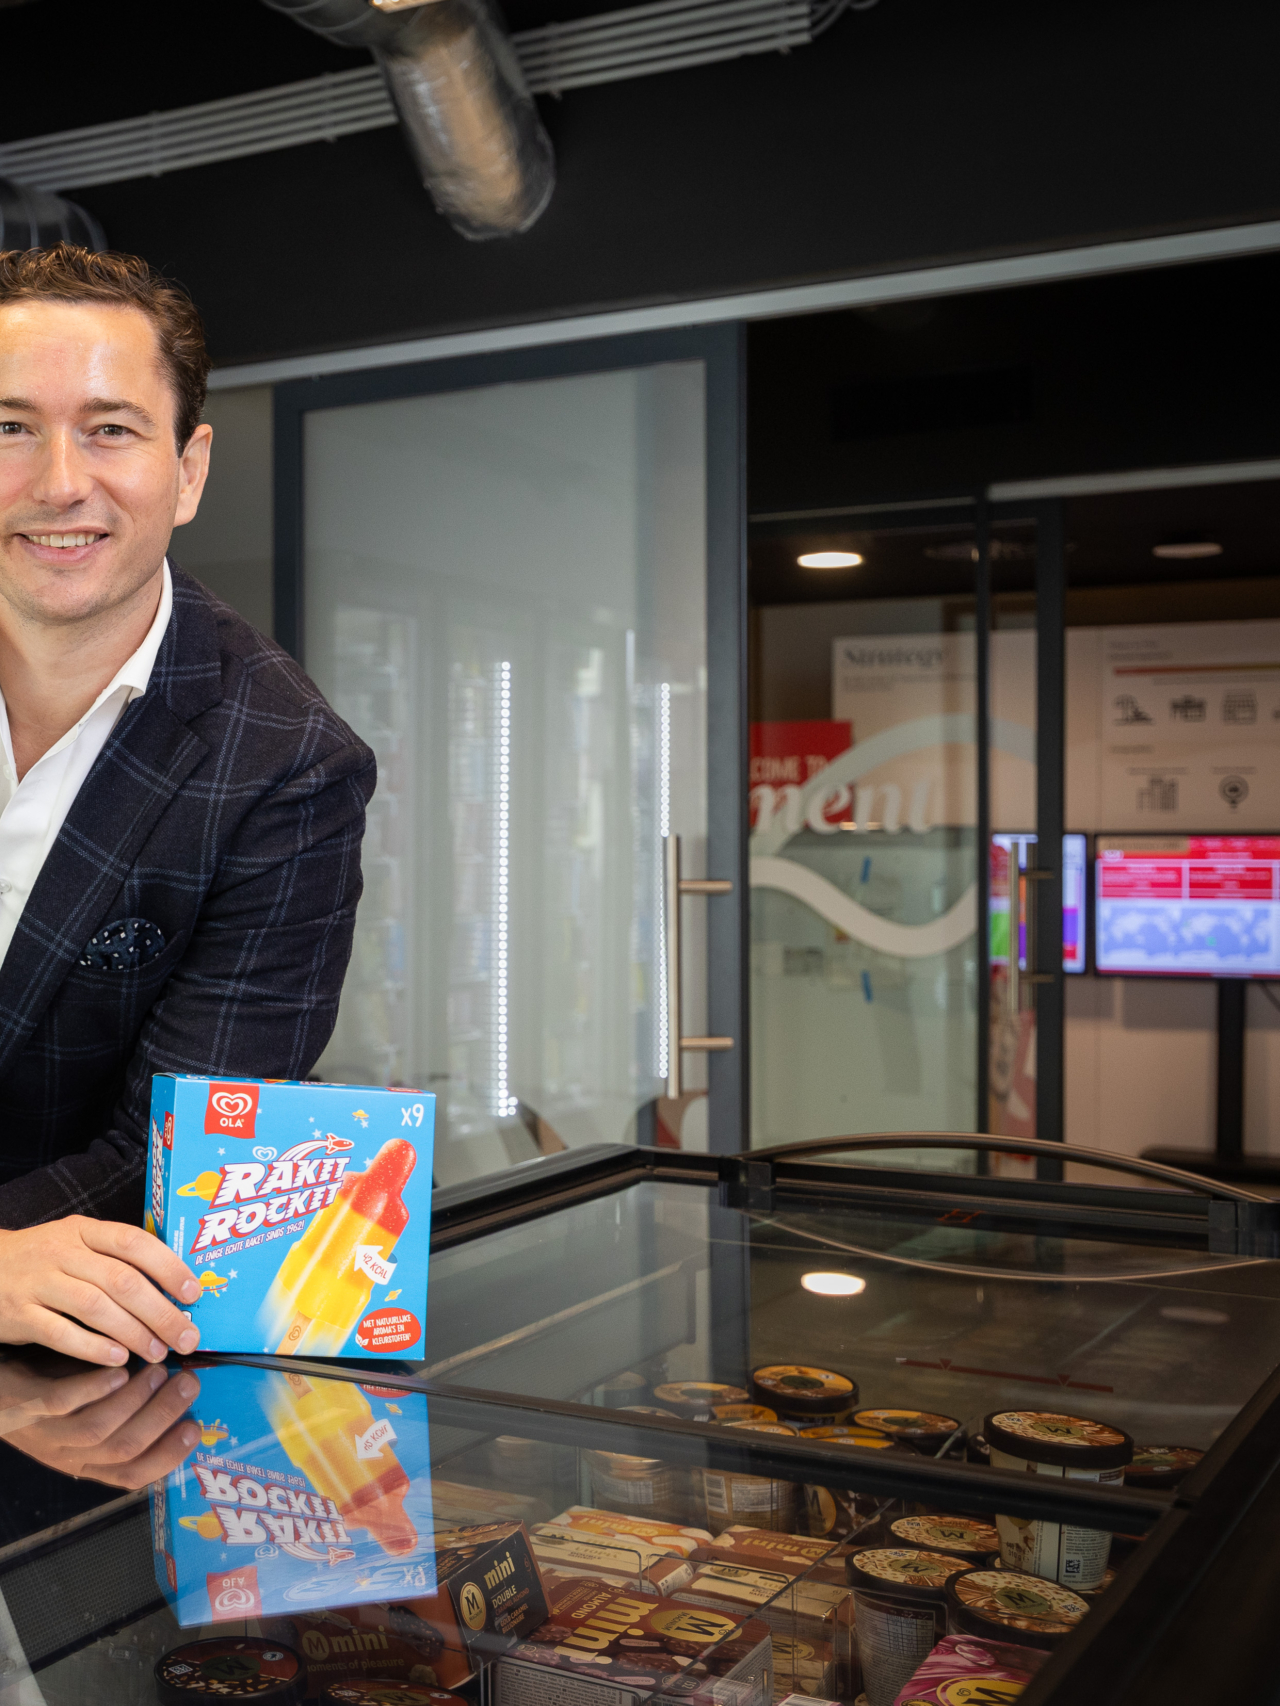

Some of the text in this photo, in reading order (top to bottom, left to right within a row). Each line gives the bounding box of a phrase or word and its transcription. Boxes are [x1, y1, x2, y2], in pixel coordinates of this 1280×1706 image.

[192, 1181, 342, 1252] ROCKET
[195, 1219, 305, 1266] DE ENIGE ECHTE RAKET SINDS 1962!
[363, 1252, 388, 1279] 42 KCAL
[363, 1314, 411, 1328] MET NATUURLIJKE
[373, 1324, 405, 1336] AROMA'S EN
[483, 1551, 516, 1590] mini
[464, 1591, 480, 1616] M
[492, 1584, 517, 1609] DOUBLE
[571, 1591, 605, 1620] ALMOND
[554, 1596, 660, 1666] mini
[670, 1612, 726, 1637] M
[307, 1624, 389, 1656] M mini
[348, 1660, 359, 1670] of
[361, 1656, 405, 1670] pleasure
